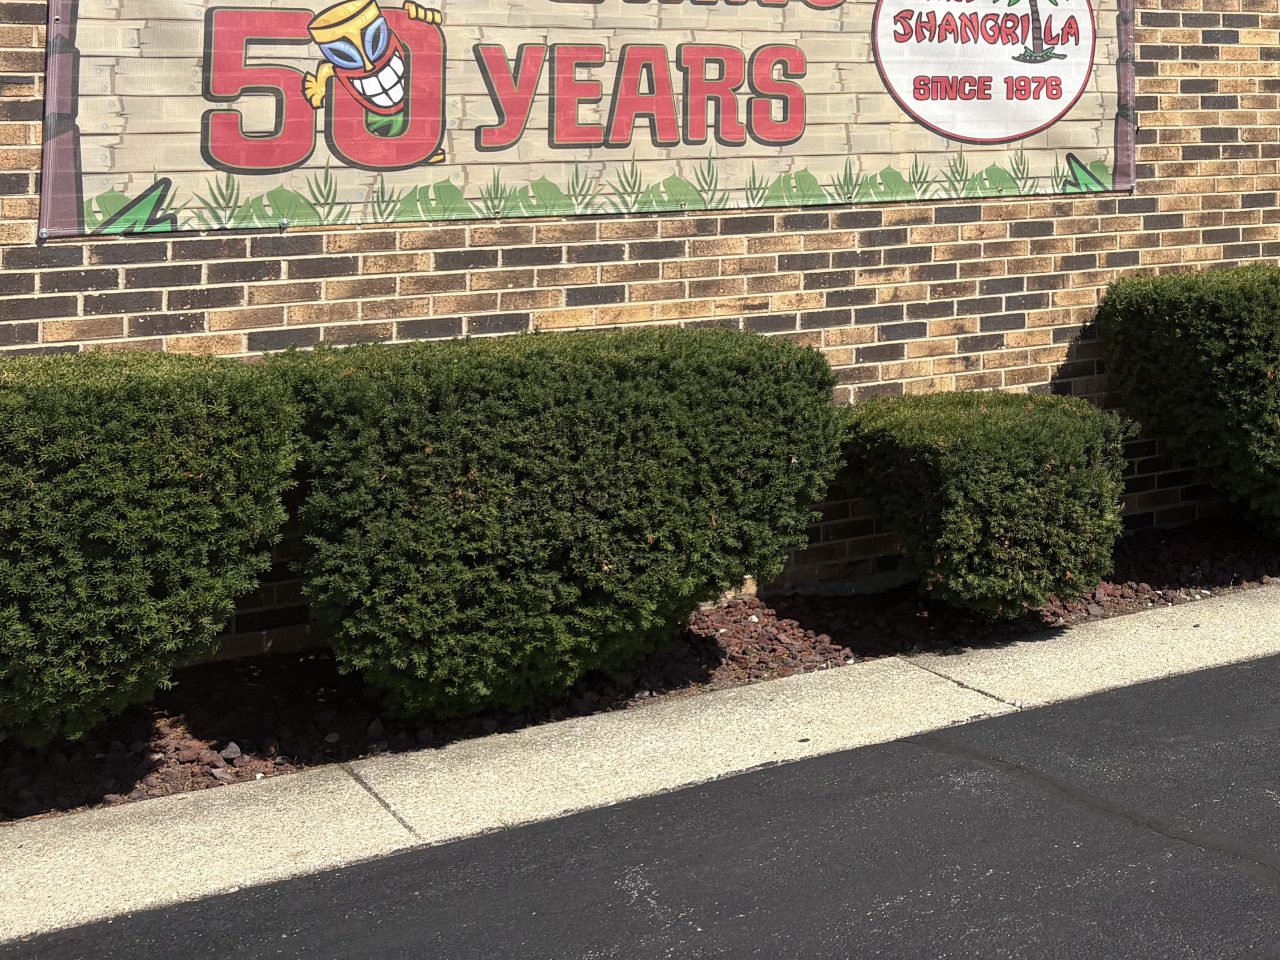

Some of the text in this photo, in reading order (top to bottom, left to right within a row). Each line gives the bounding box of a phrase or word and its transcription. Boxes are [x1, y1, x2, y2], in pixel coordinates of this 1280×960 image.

[893, 8, 1080, 46] SHANGRI LA
[200, 7, 807, 174] 50 YEARS
[912, 75, 1063, 101] SINCE 1976
